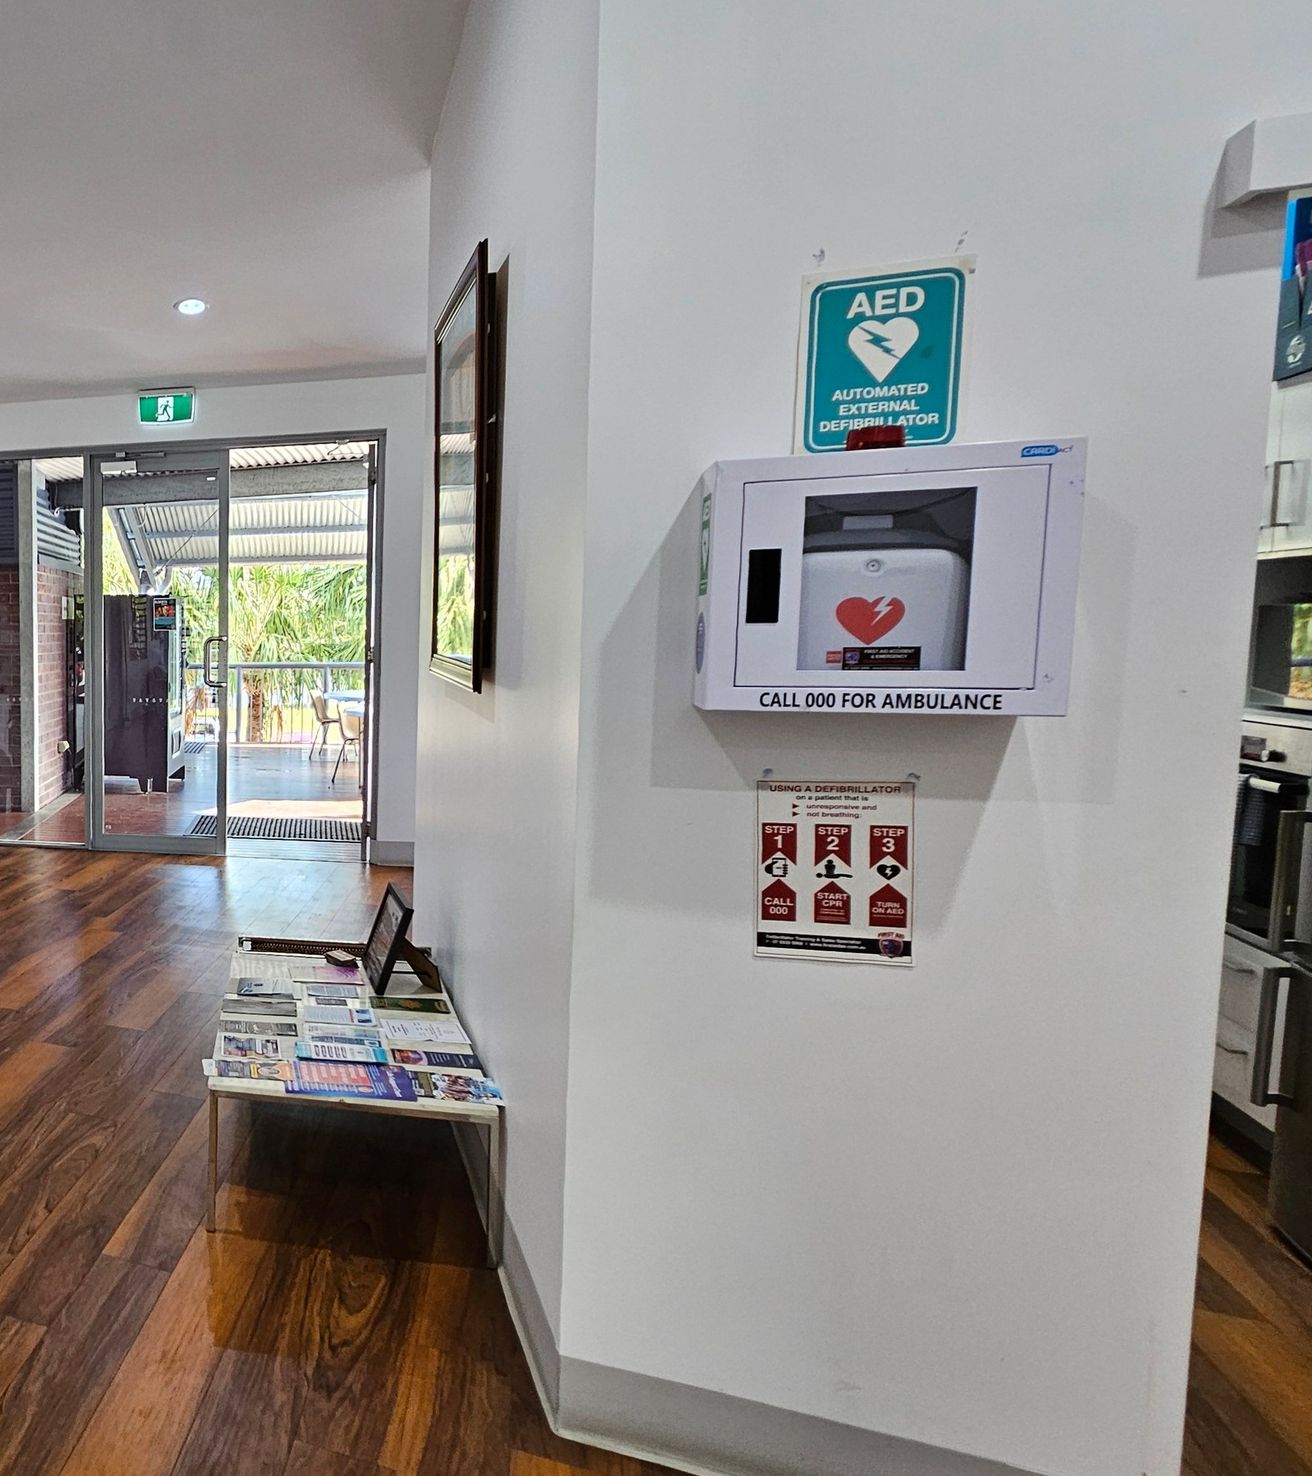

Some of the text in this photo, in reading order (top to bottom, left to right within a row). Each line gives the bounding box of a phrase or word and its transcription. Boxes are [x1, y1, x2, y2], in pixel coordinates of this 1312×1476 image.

[846, 286, 926, 319] AED
[832, 383, 929, 401] AUTOMATED
[839, 399, 920, 416] EXTERNAL
[819, 413, 939, 432] DEFIBRILLATOR
[760, 692, 1002, 710] CALL 000 FOR AMBULANCE
[769, 785, 901, 794] USING A DEFIBRILLATOR
[814, 794, 842, 802] patient
[764, 825, 794, 834] STEP
[818, 826, 849, 835] STEP
[873, 828, 905, 837] STEP
[773, 835, 783, 849] 1
[826, 836, 839, 850] 2
[881, 837, 895, 852] 3
[817, 892, 849, 900] START
[764, 897, 794, 906] CALL
[822, 900, 843, 908] CPR
[769, 907, 788, 915] 000
